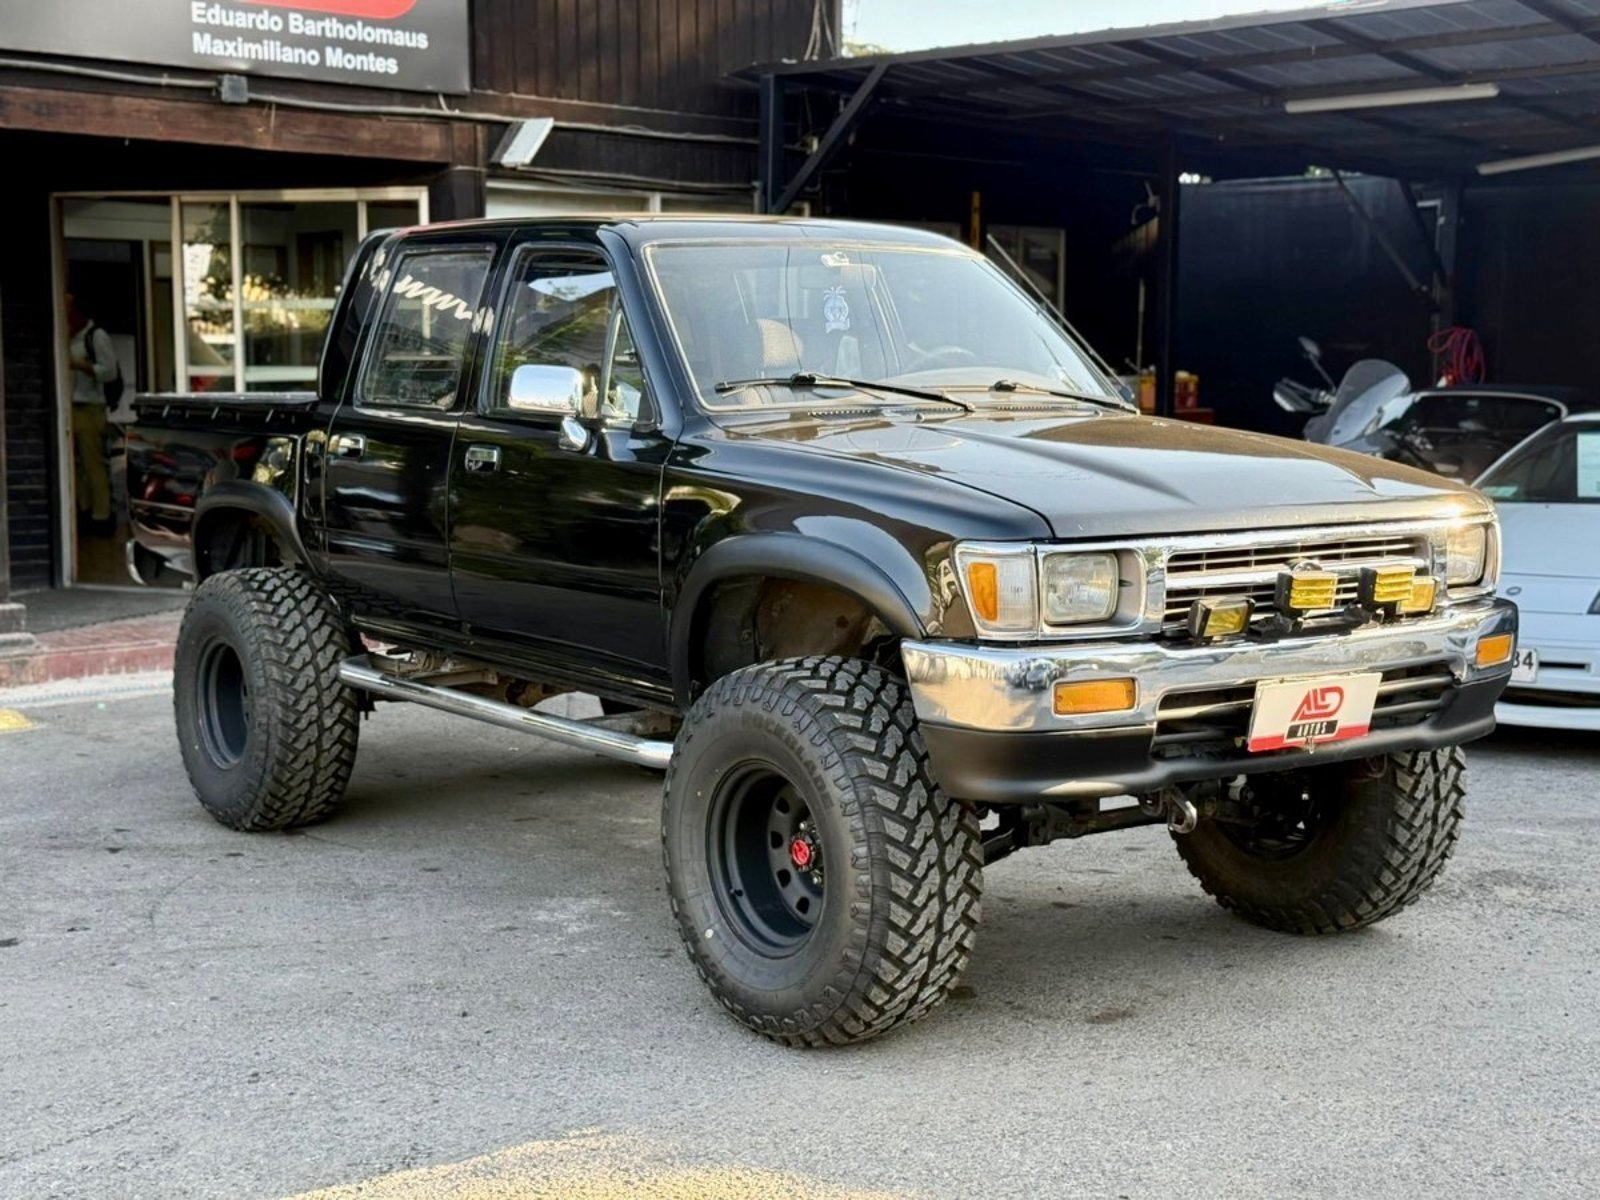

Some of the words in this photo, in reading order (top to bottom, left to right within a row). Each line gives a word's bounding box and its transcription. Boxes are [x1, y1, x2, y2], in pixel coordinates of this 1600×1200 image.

[191, 1, 283, 32] Eduardo
[288, 12, 429, 49] Bartholomaus
[192, 32, 320, 66] Maximiliano
[325, 46, 399, 74] Montes
